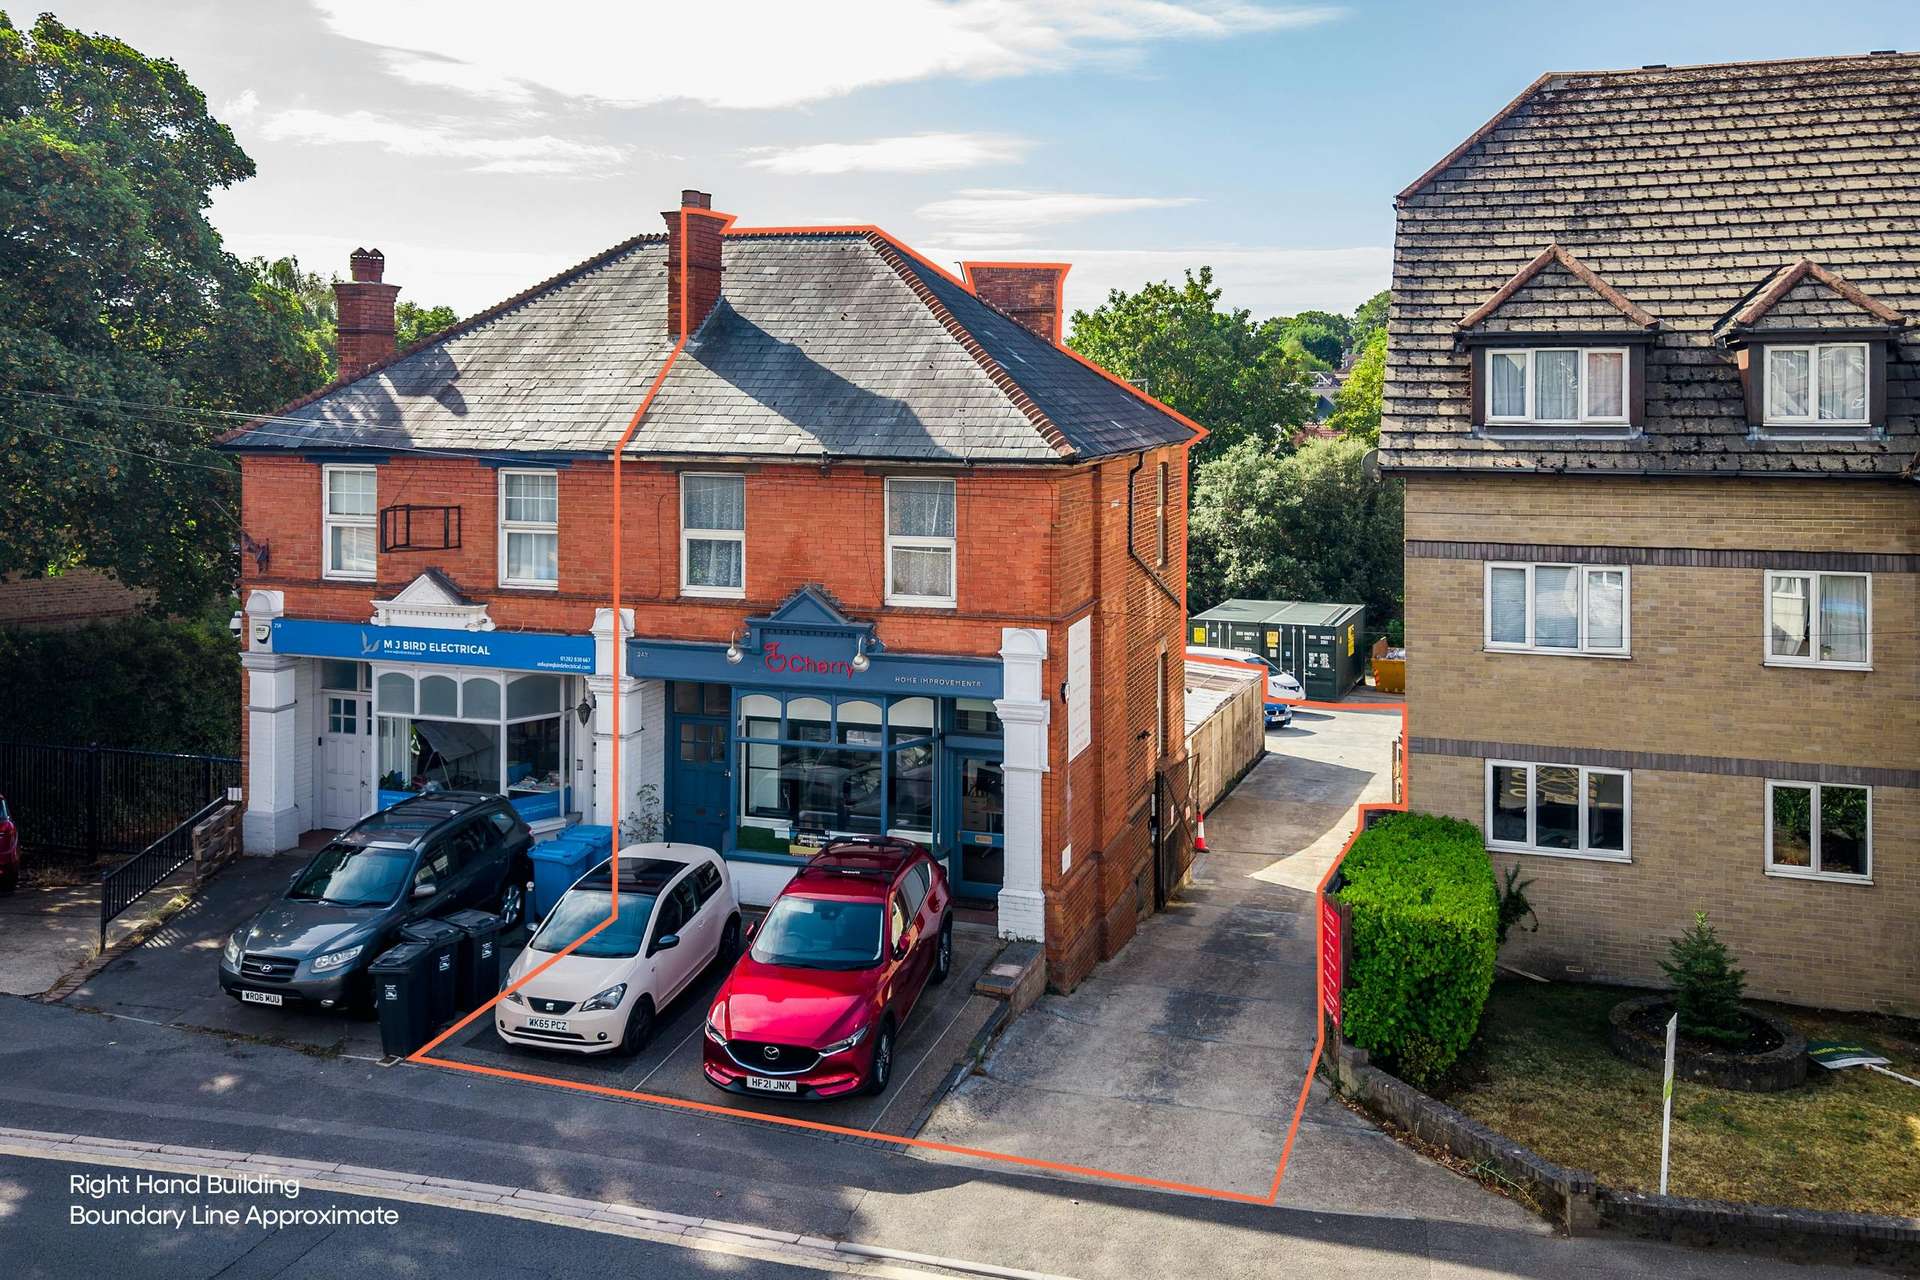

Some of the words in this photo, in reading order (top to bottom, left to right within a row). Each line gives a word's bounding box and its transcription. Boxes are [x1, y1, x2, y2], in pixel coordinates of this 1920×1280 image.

[384, 640, 392, 649] M
[395, 640, 400, 650] J
[403, 641, 427, 651] BIRD
[429, 643, 491, 655] ELECTRICAL
[787, 655, 854, 679] Cherry
[895, 676, 917, 684] HOME
[920, 677, 983, 687] IMPROVEMENTS
[528, 1017, 549, 1029] WK65
[550, 1020, 567, 1031] PCZ
[752, 1078, 772, 1089] HF21
[773, 1080, 791, 1090] JNK
